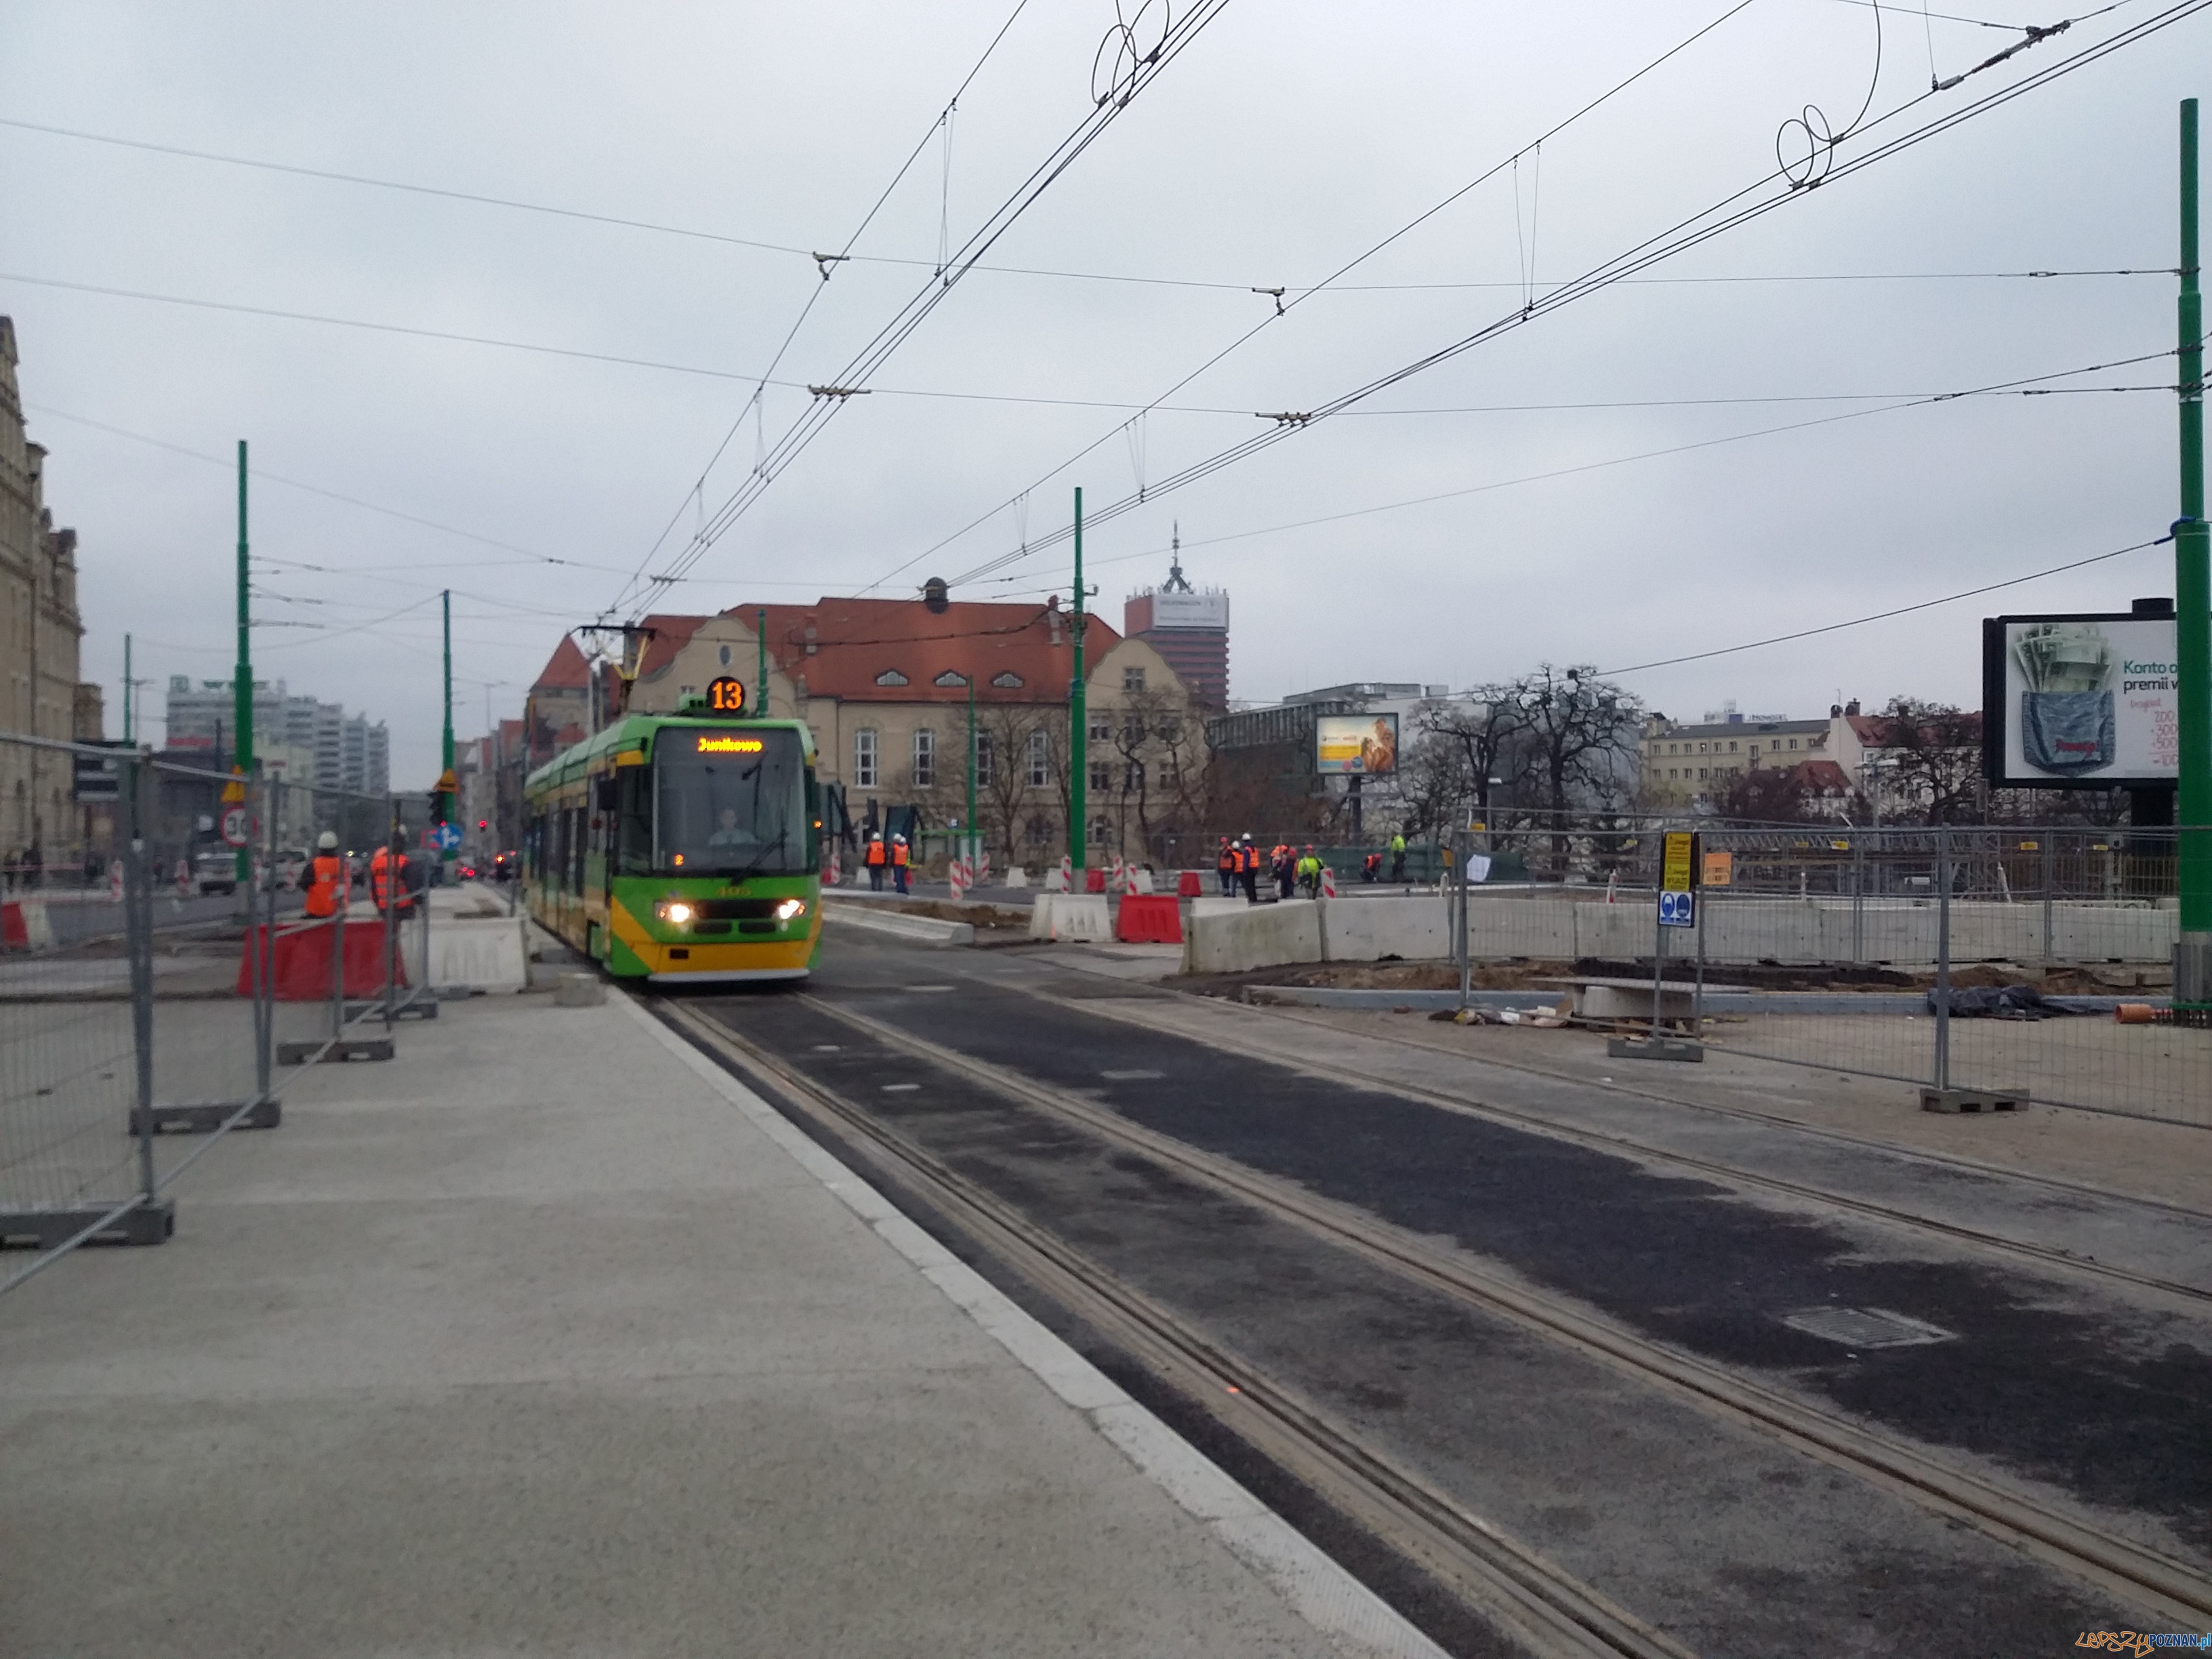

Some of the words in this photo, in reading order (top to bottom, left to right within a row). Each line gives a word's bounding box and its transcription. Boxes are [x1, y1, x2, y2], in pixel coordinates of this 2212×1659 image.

[2124, 659, 2167, 674] Konto
[2123, 676, 2169, 695] premii
[711, 680, 743, 710] 13
[698, 737, 762, 752] Junikowo
